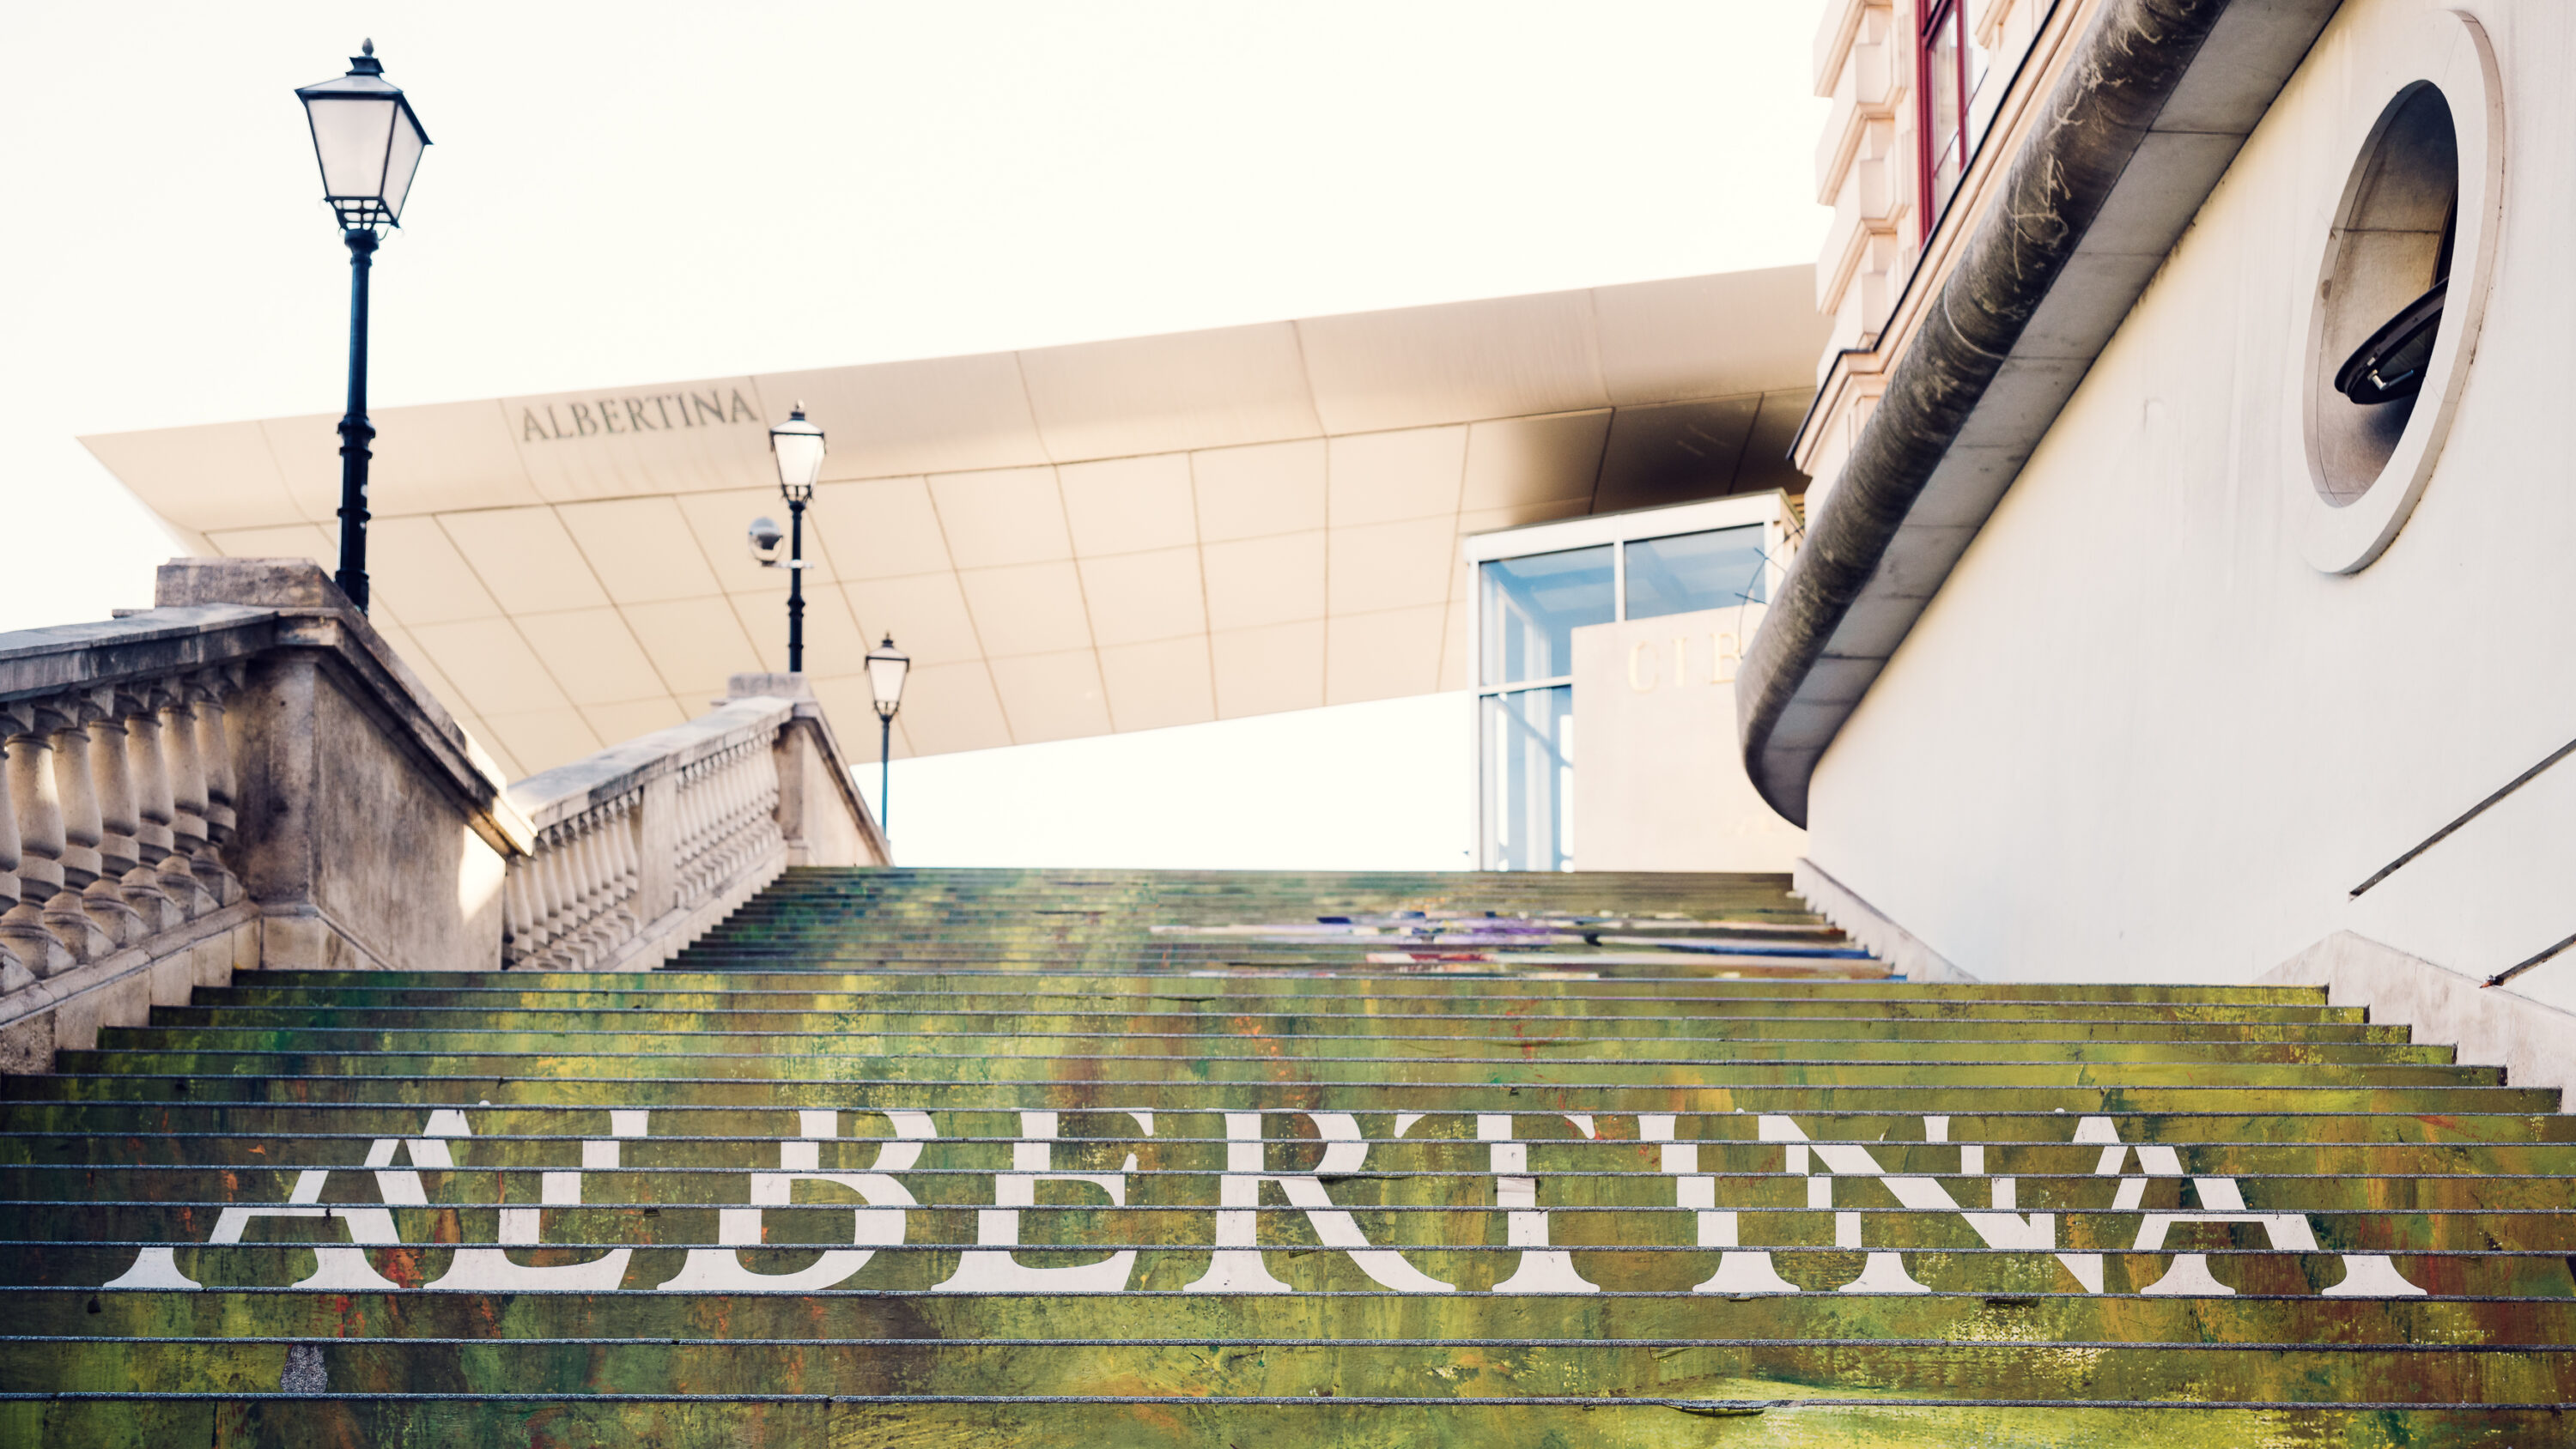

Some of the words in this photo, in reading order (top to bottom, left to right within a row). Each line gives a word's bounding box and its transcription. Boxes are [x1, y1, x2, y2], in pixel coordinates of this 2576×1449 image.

[523, 388, 758, 441] ALBERTINA
[1630, 628, 1756, 694] CIB
[103, 1100, 2427, 1297] ALBERTINA
